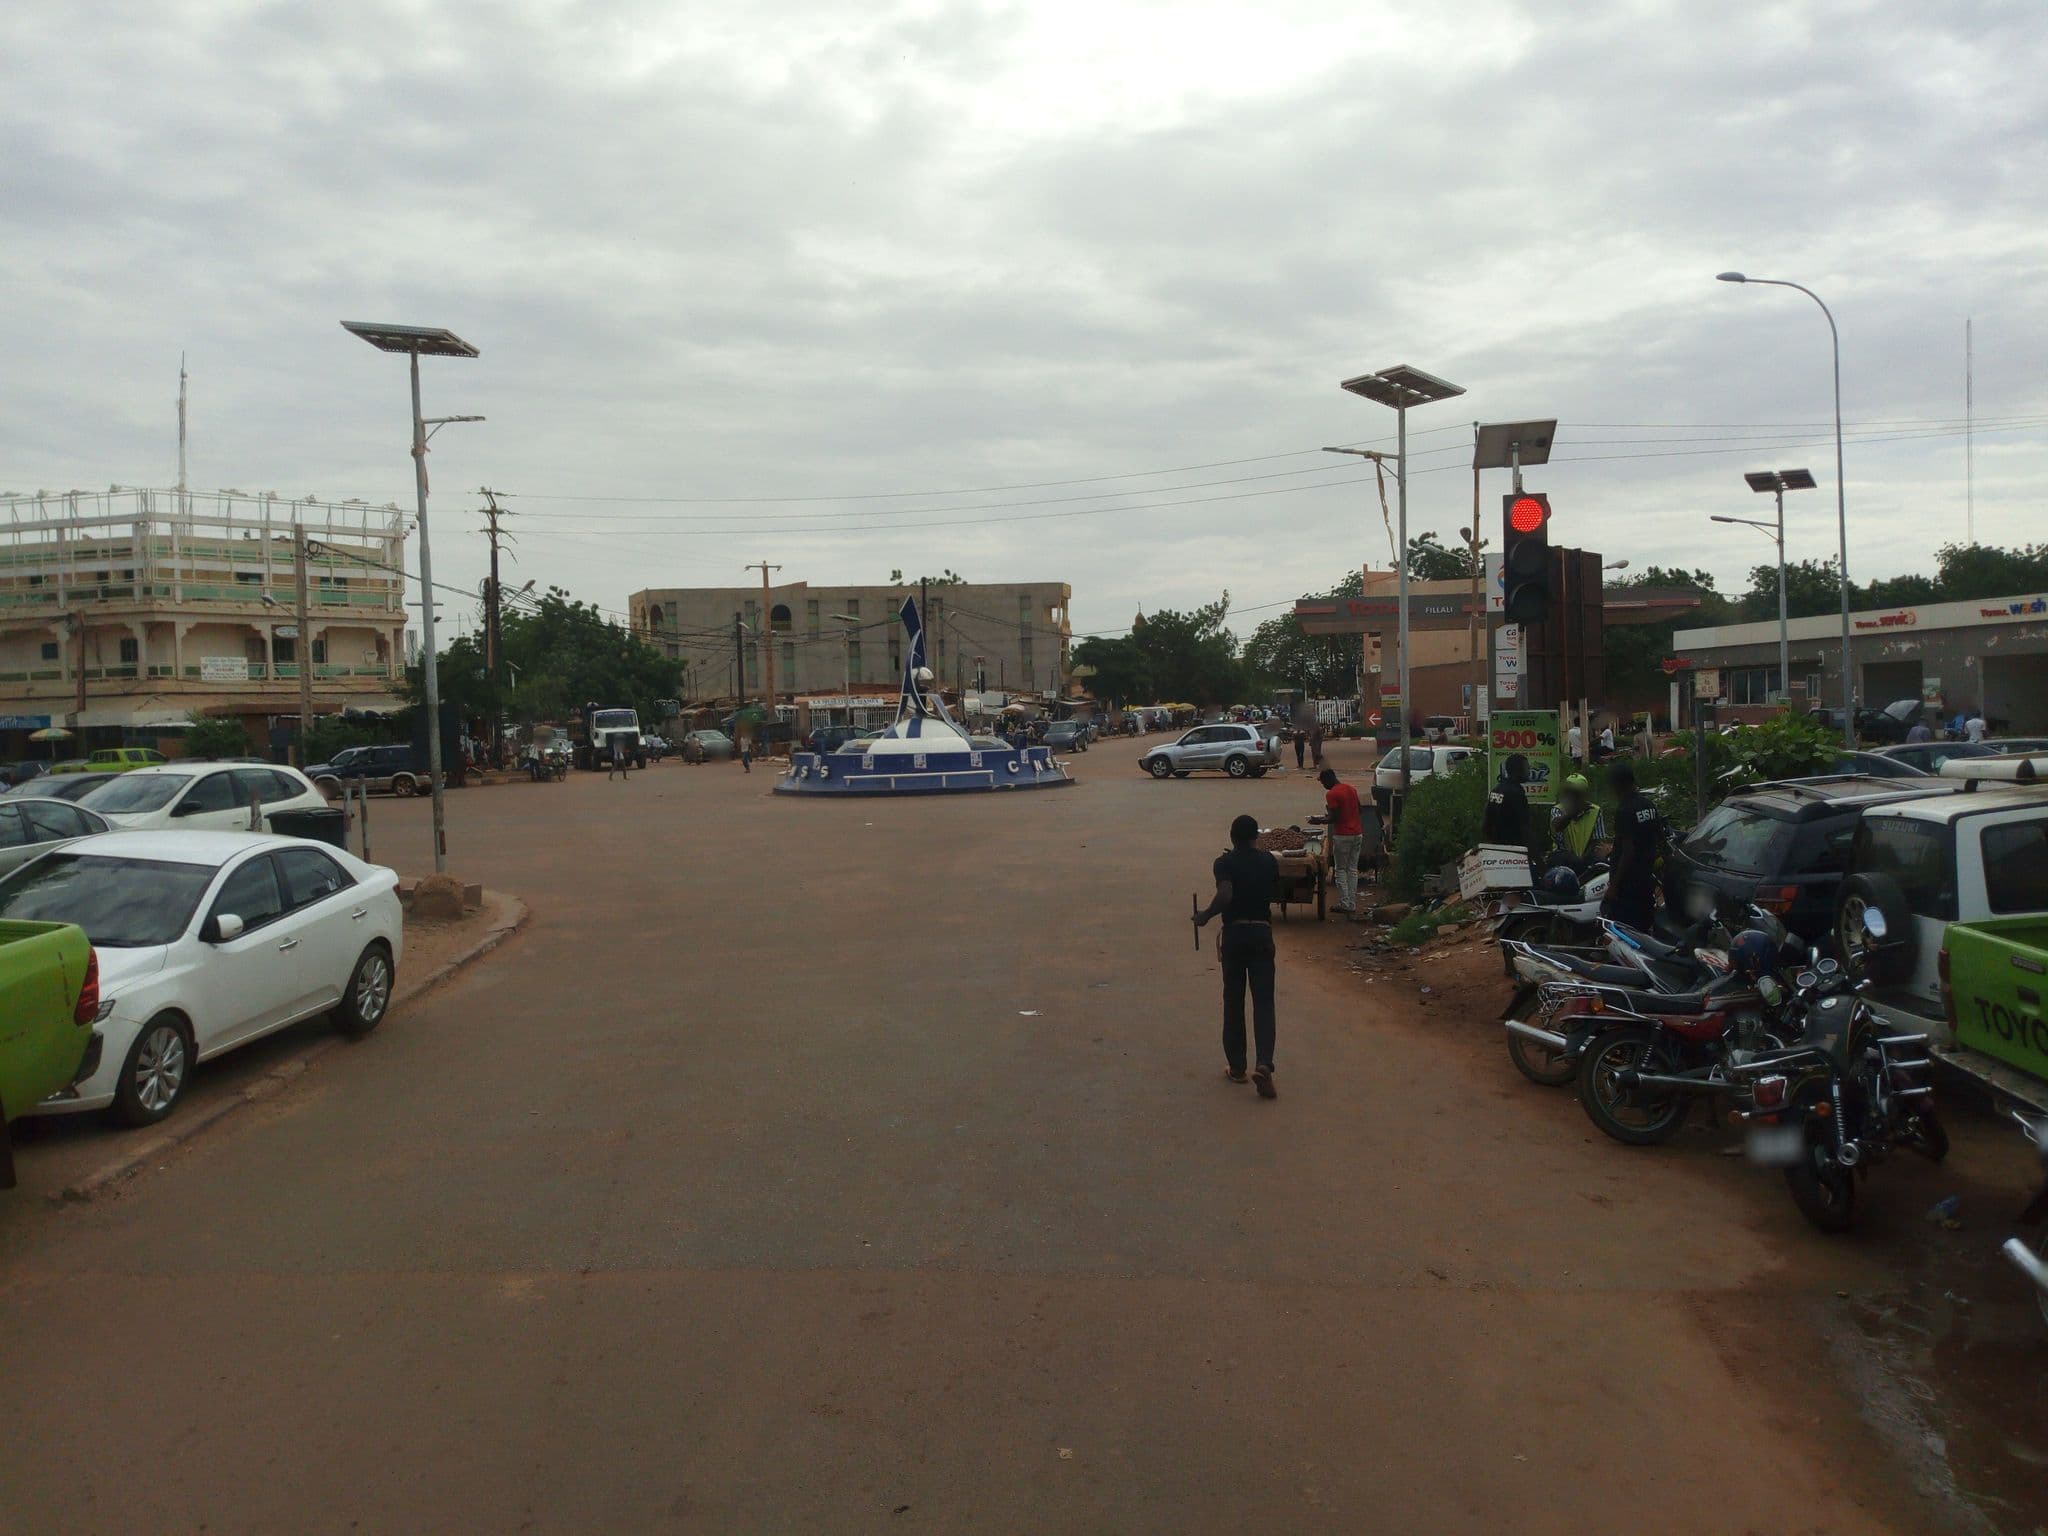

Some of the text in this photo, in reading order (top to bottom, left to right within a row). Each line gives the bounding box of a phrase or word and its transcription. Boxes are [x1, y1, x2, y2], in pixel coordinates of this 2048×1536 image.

[1511, 719, 1536, 727] JEUDI
[1492, 730, 1556, 749] 300%
[1590, 883, 1605, 894] TOP
